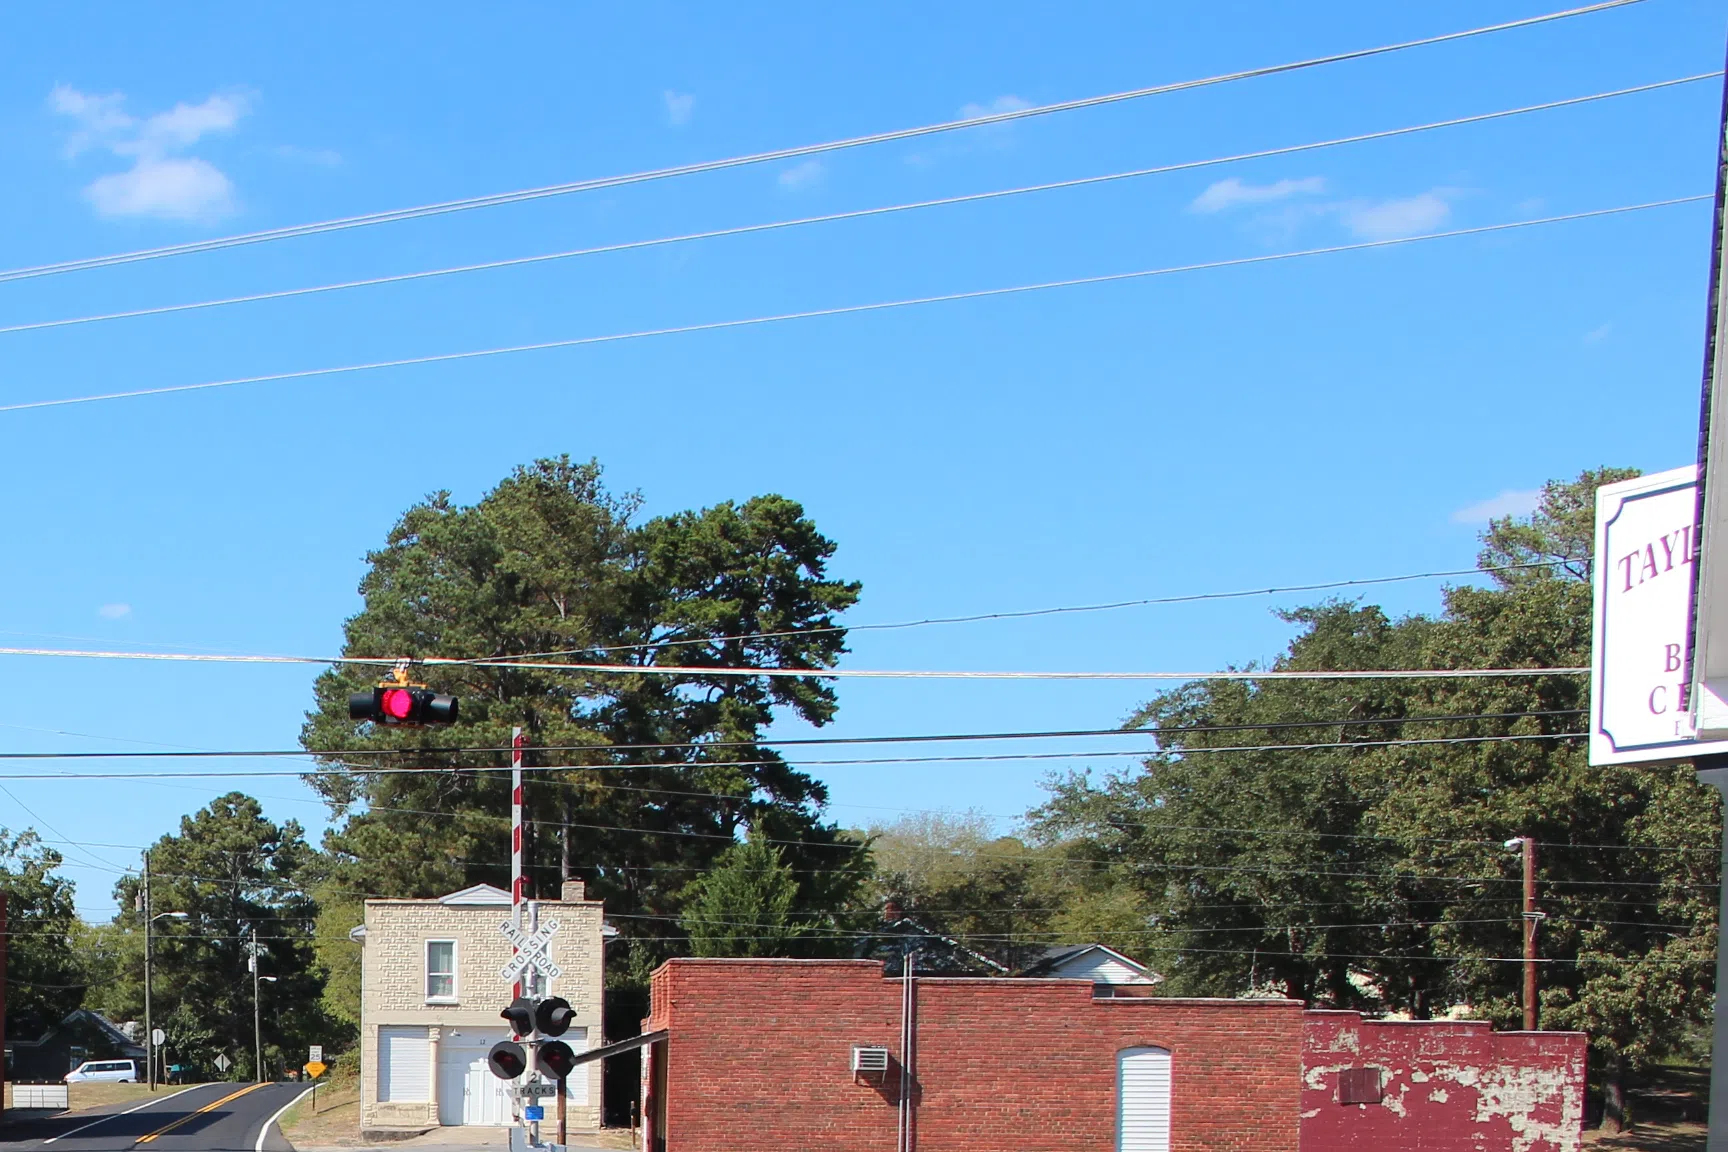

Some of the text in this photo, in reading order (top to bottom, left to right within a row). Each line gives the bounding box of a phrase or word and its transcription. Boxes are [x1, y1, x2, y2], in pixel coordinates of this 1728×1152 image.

[502, 920, 558, 979] CROSSING
[530, 1072, 537, 1083] 2
[514, 1087, 555, 1095] TRACKS
